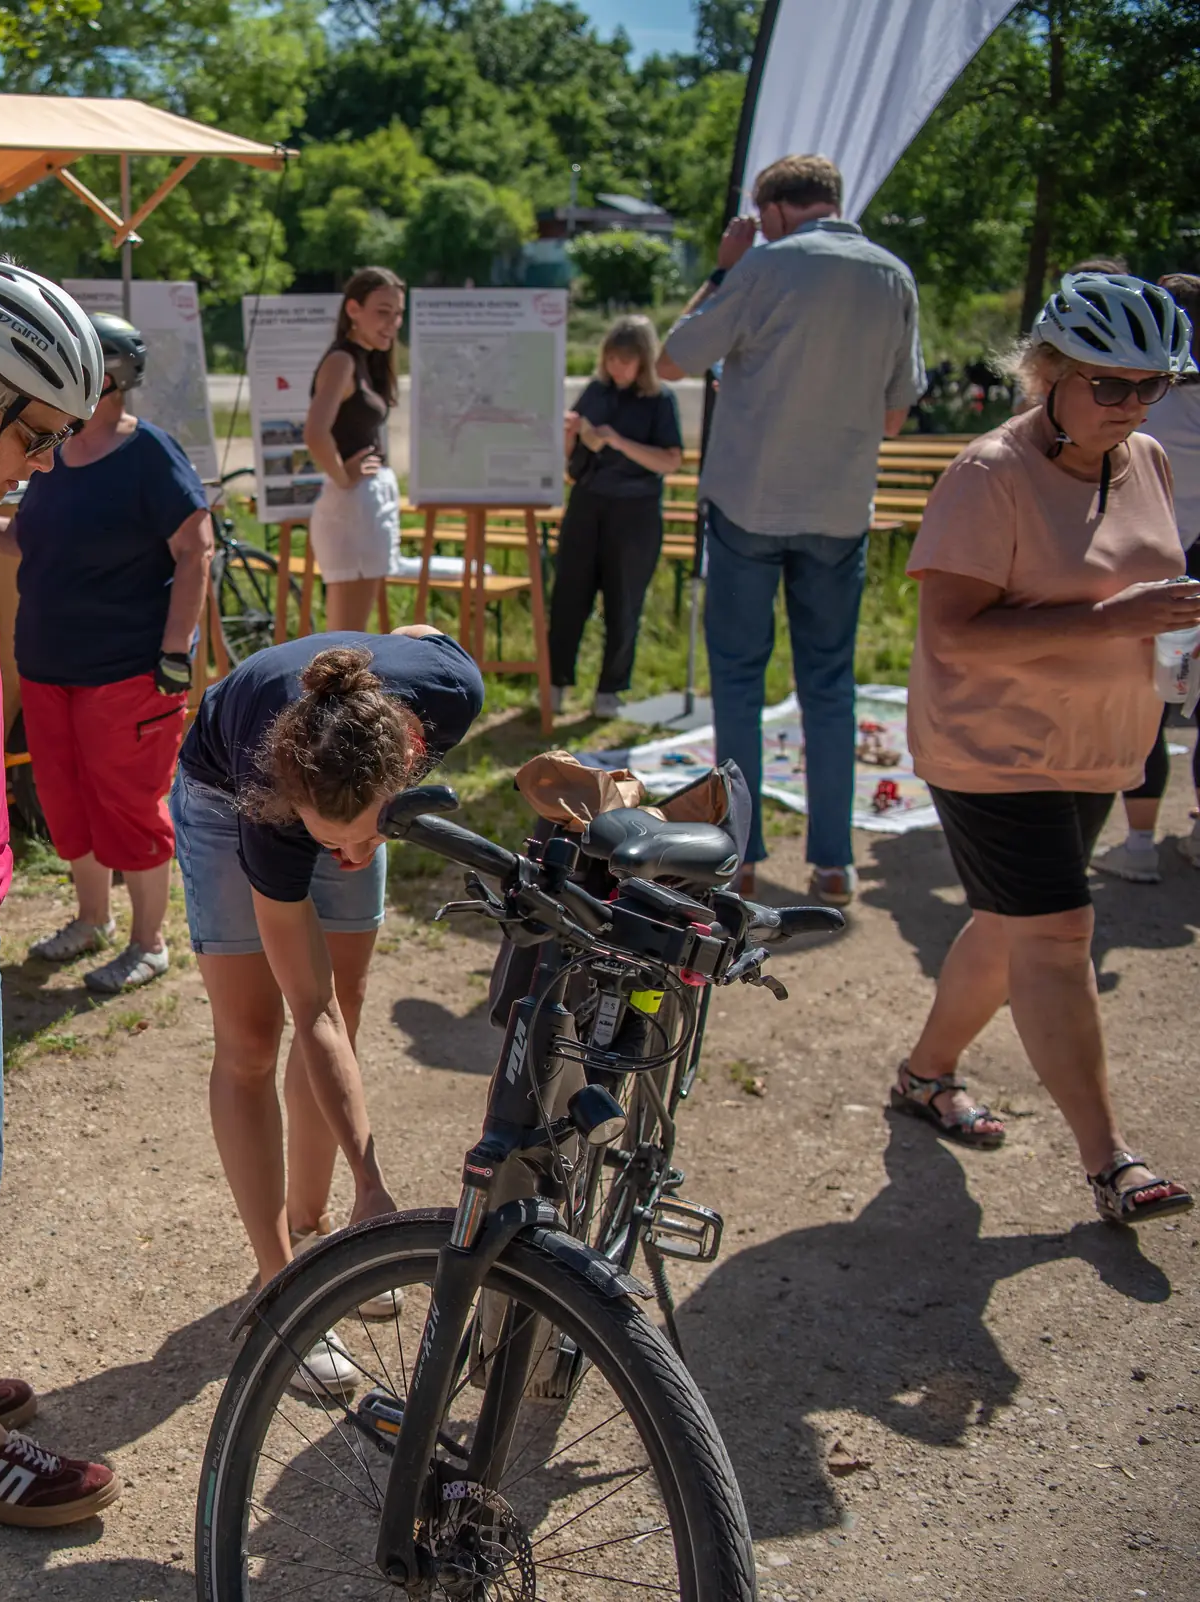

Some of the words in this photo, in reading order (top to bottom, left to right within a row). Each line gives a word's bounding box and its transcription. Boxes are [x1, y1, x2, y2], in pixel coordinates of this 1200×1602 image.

[11, 321, 49, 351] GIRO
[211, 1431, 226, 1470] PLUS
[203, 1527, 212, 1602] SCHWALBE
